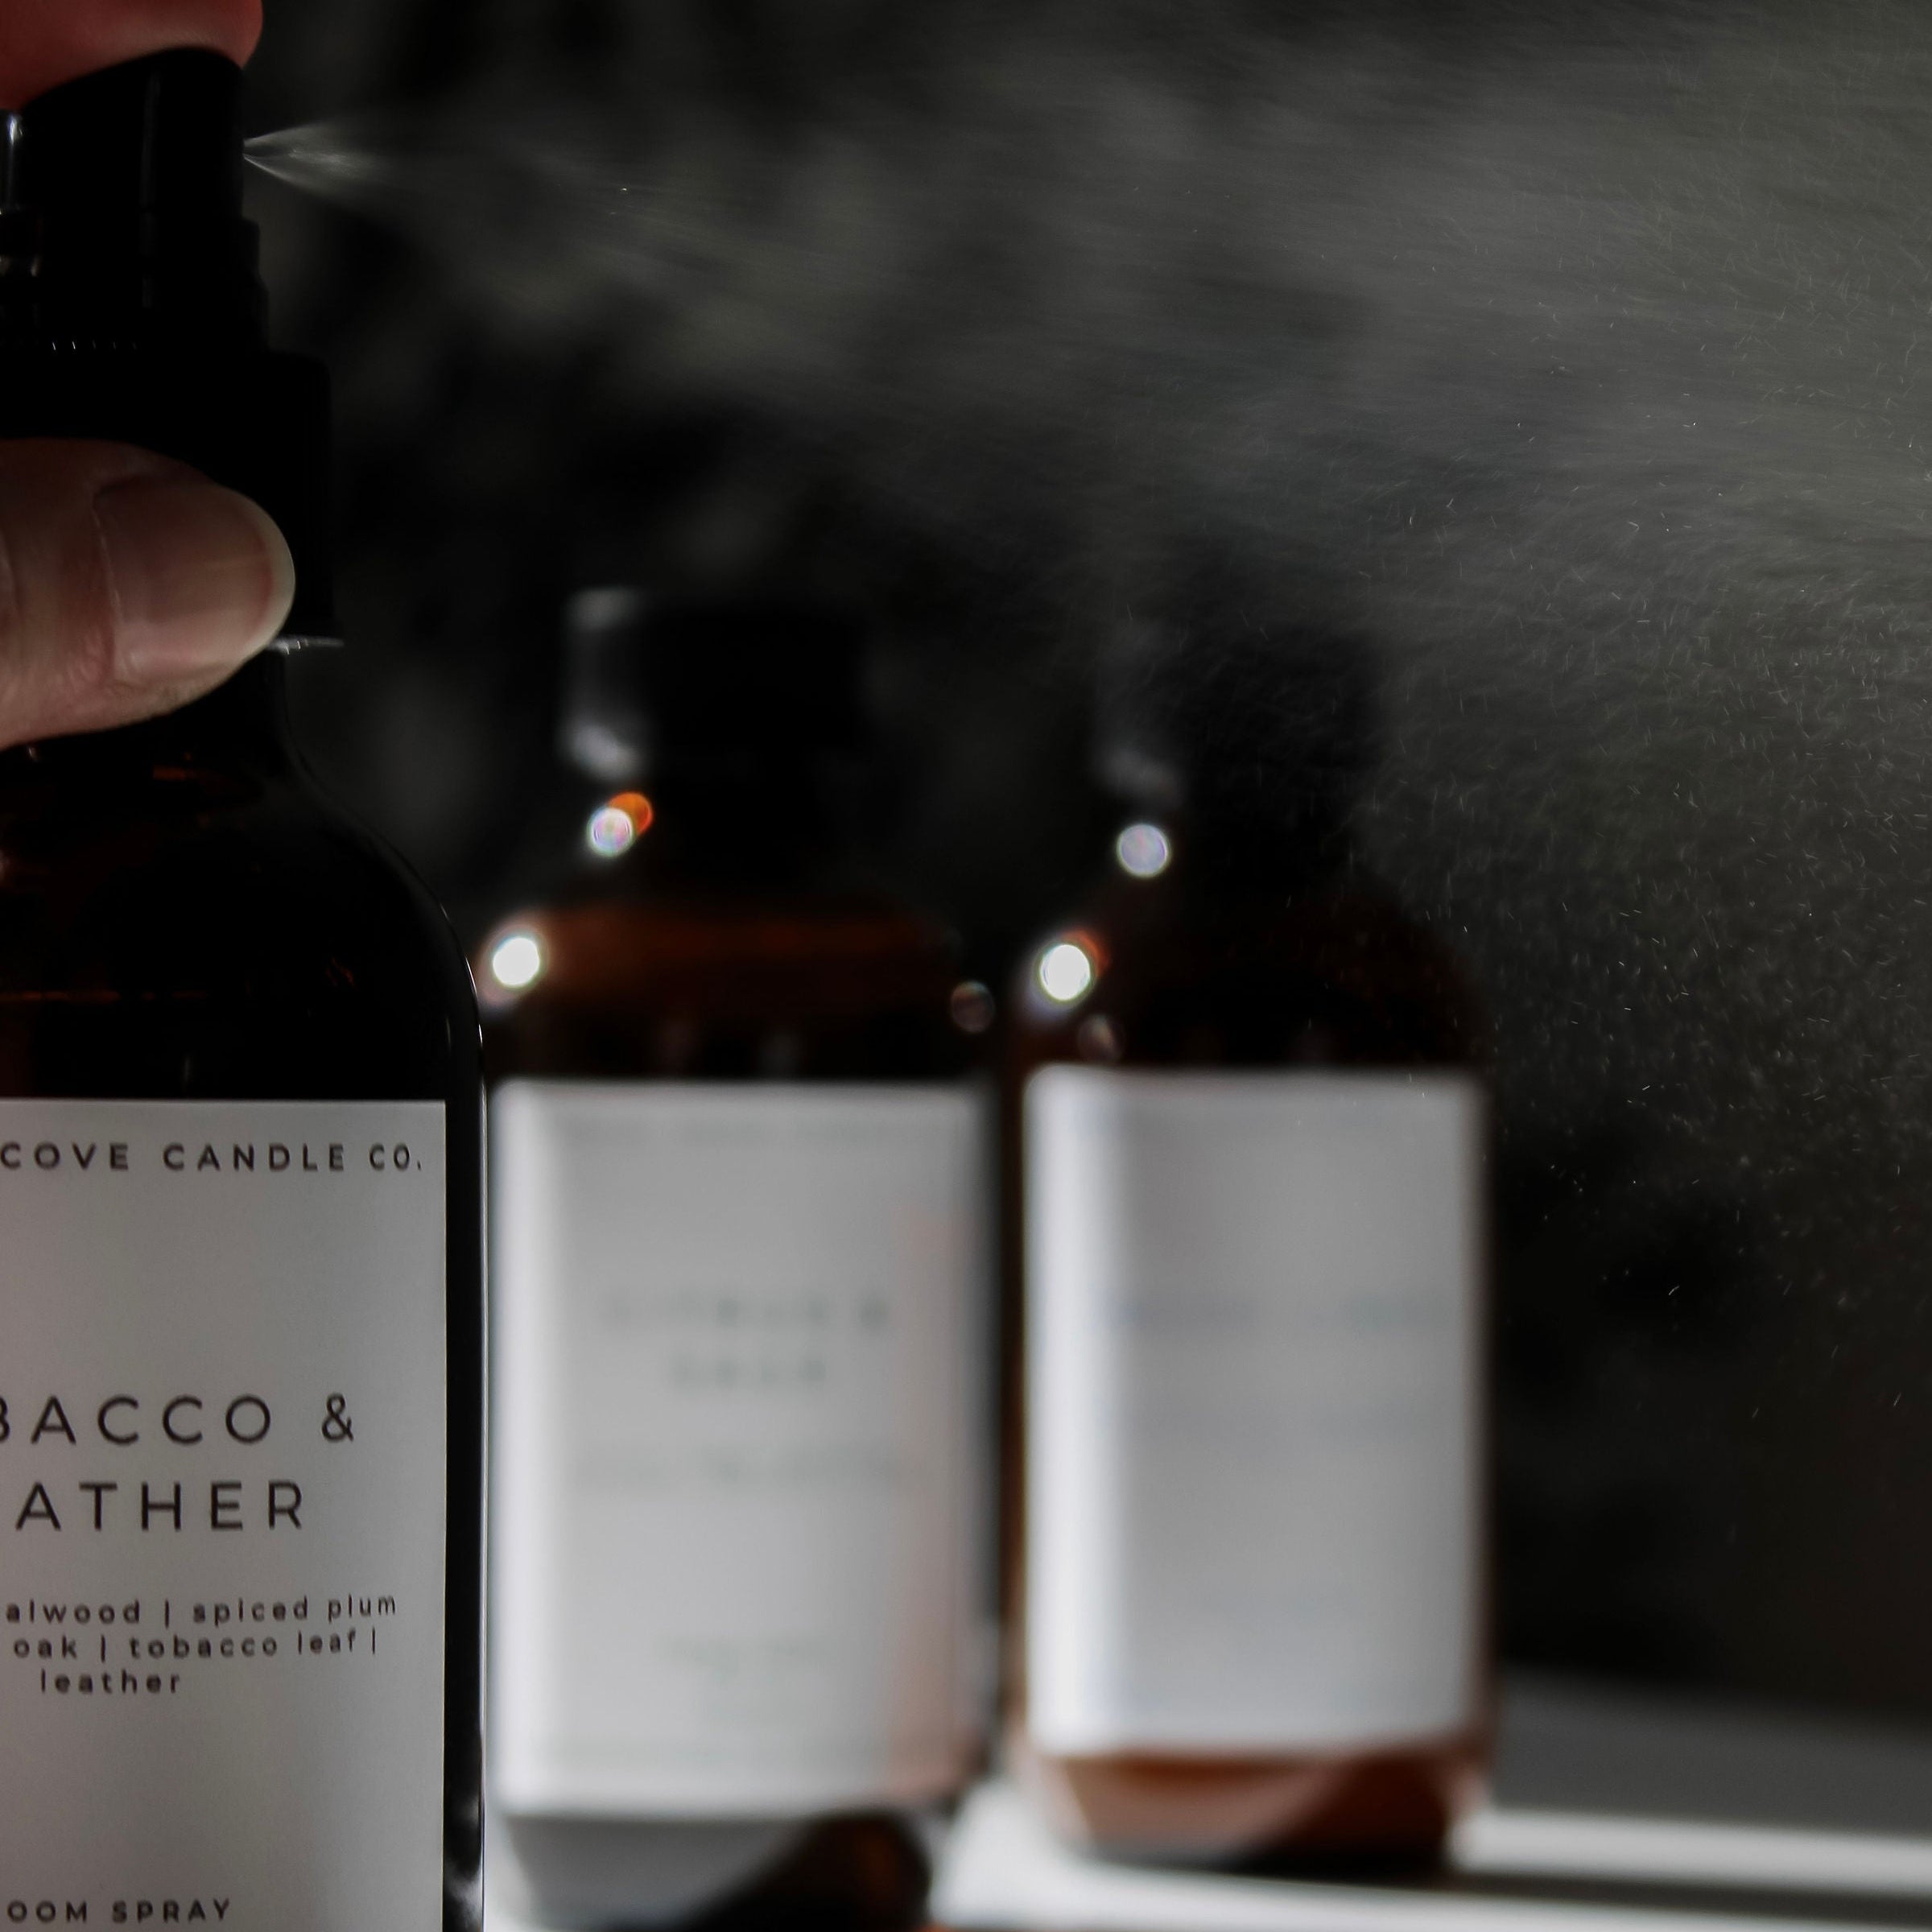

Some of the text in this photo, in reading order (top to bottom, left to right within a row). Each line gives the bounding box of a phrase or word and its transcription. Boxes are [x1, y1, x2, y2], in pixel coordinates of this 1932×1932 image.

[0, 1141, 422, 1172] COVE CANDLE CO.
[321, 1393, 354, 1443] &
[14, 1480, 303, 1532] ATHER
[6, 1599, 140, 1624] alwood
[192, 1596, 308, 1628] spiced
[328, 1593, 396, 1624] plum
[13, 1634, 77, 1659] oak
[129, 1635, 278, 1660] tobacco
[297, 1628, 357, 1655] leaf
[40, 1669, 180, 1694] leather
[6, 1899, 230, 1924] OOM SPRAY
